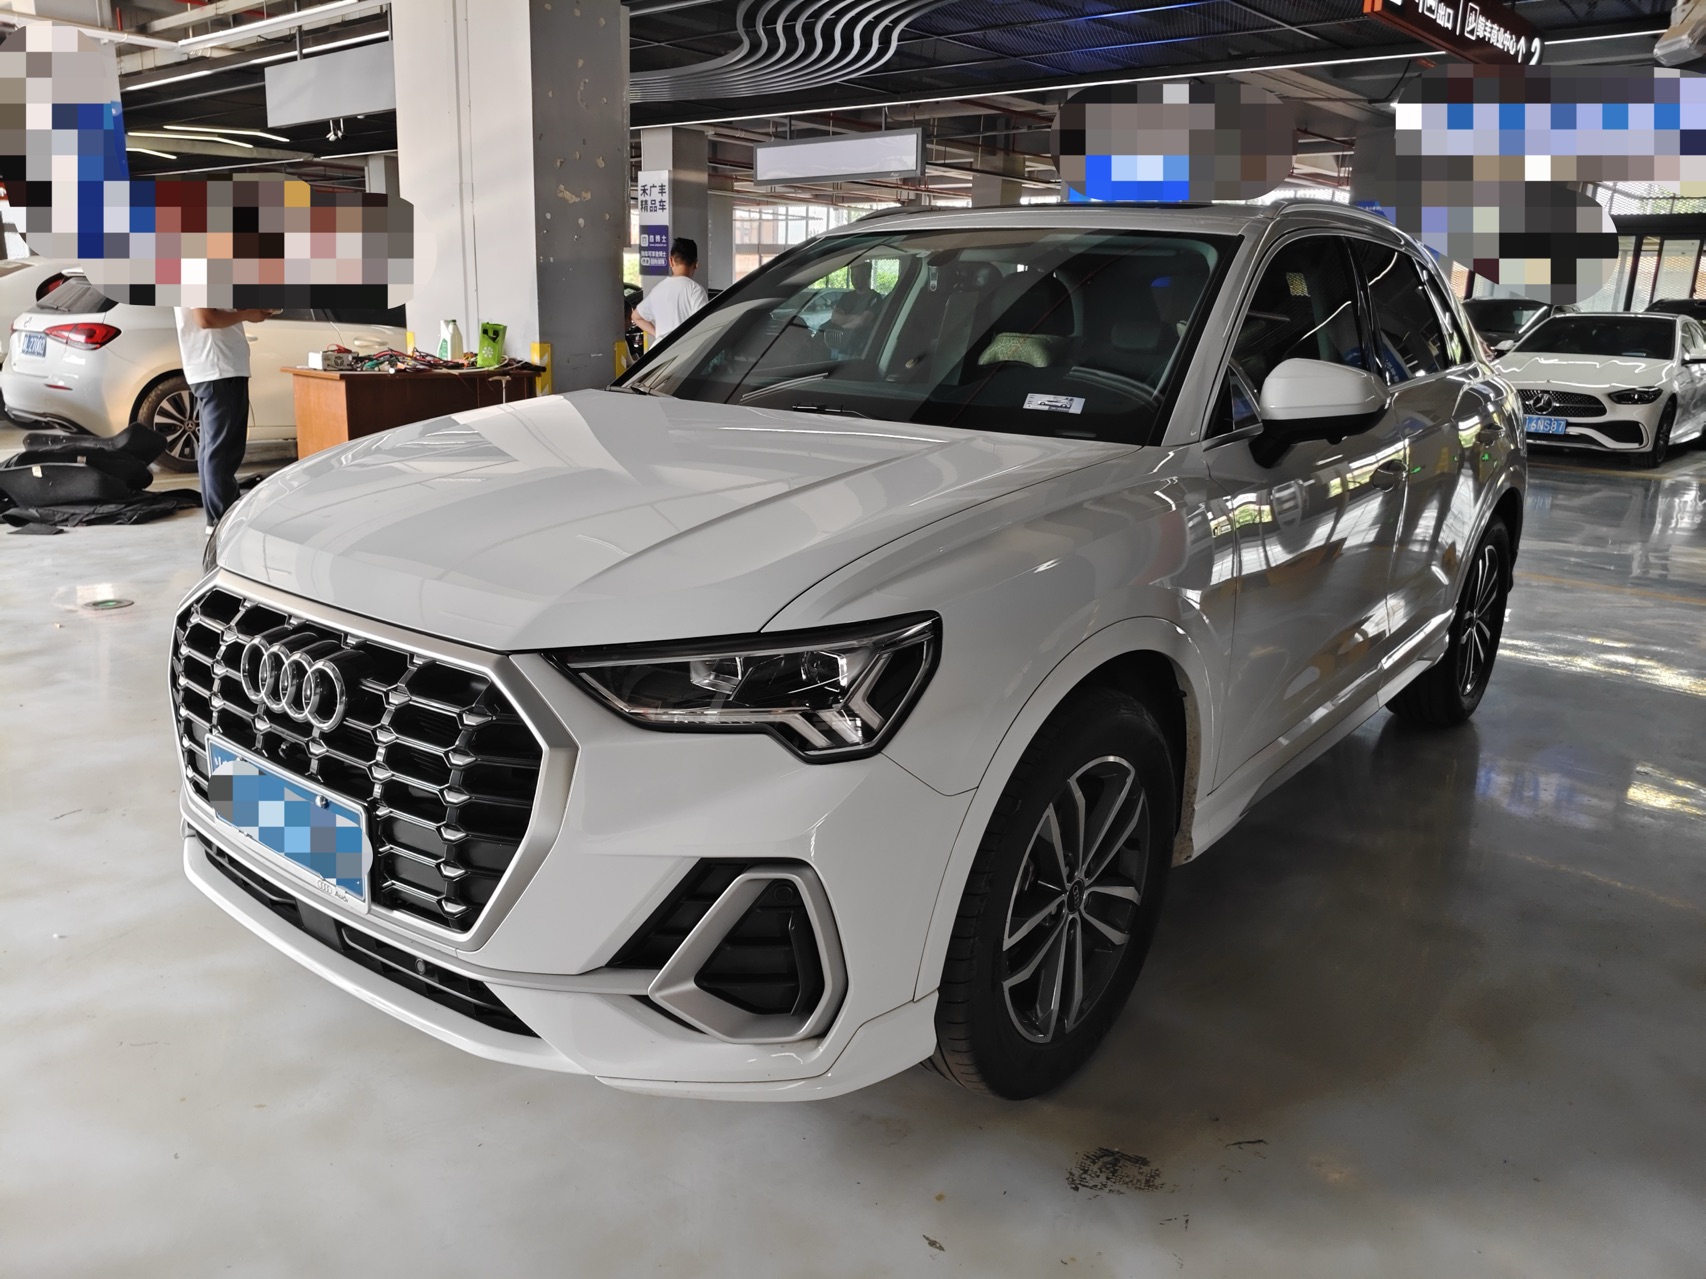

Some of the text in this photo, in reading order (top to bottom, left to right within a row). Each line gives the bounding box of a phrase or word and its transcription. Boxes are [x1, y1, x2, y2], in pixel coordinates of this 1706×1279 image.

[1436, 2, 1454, 30] 出口
[640, 183, 667, 197] 禾广丰
[640, 199, 667, 212] 精品车
